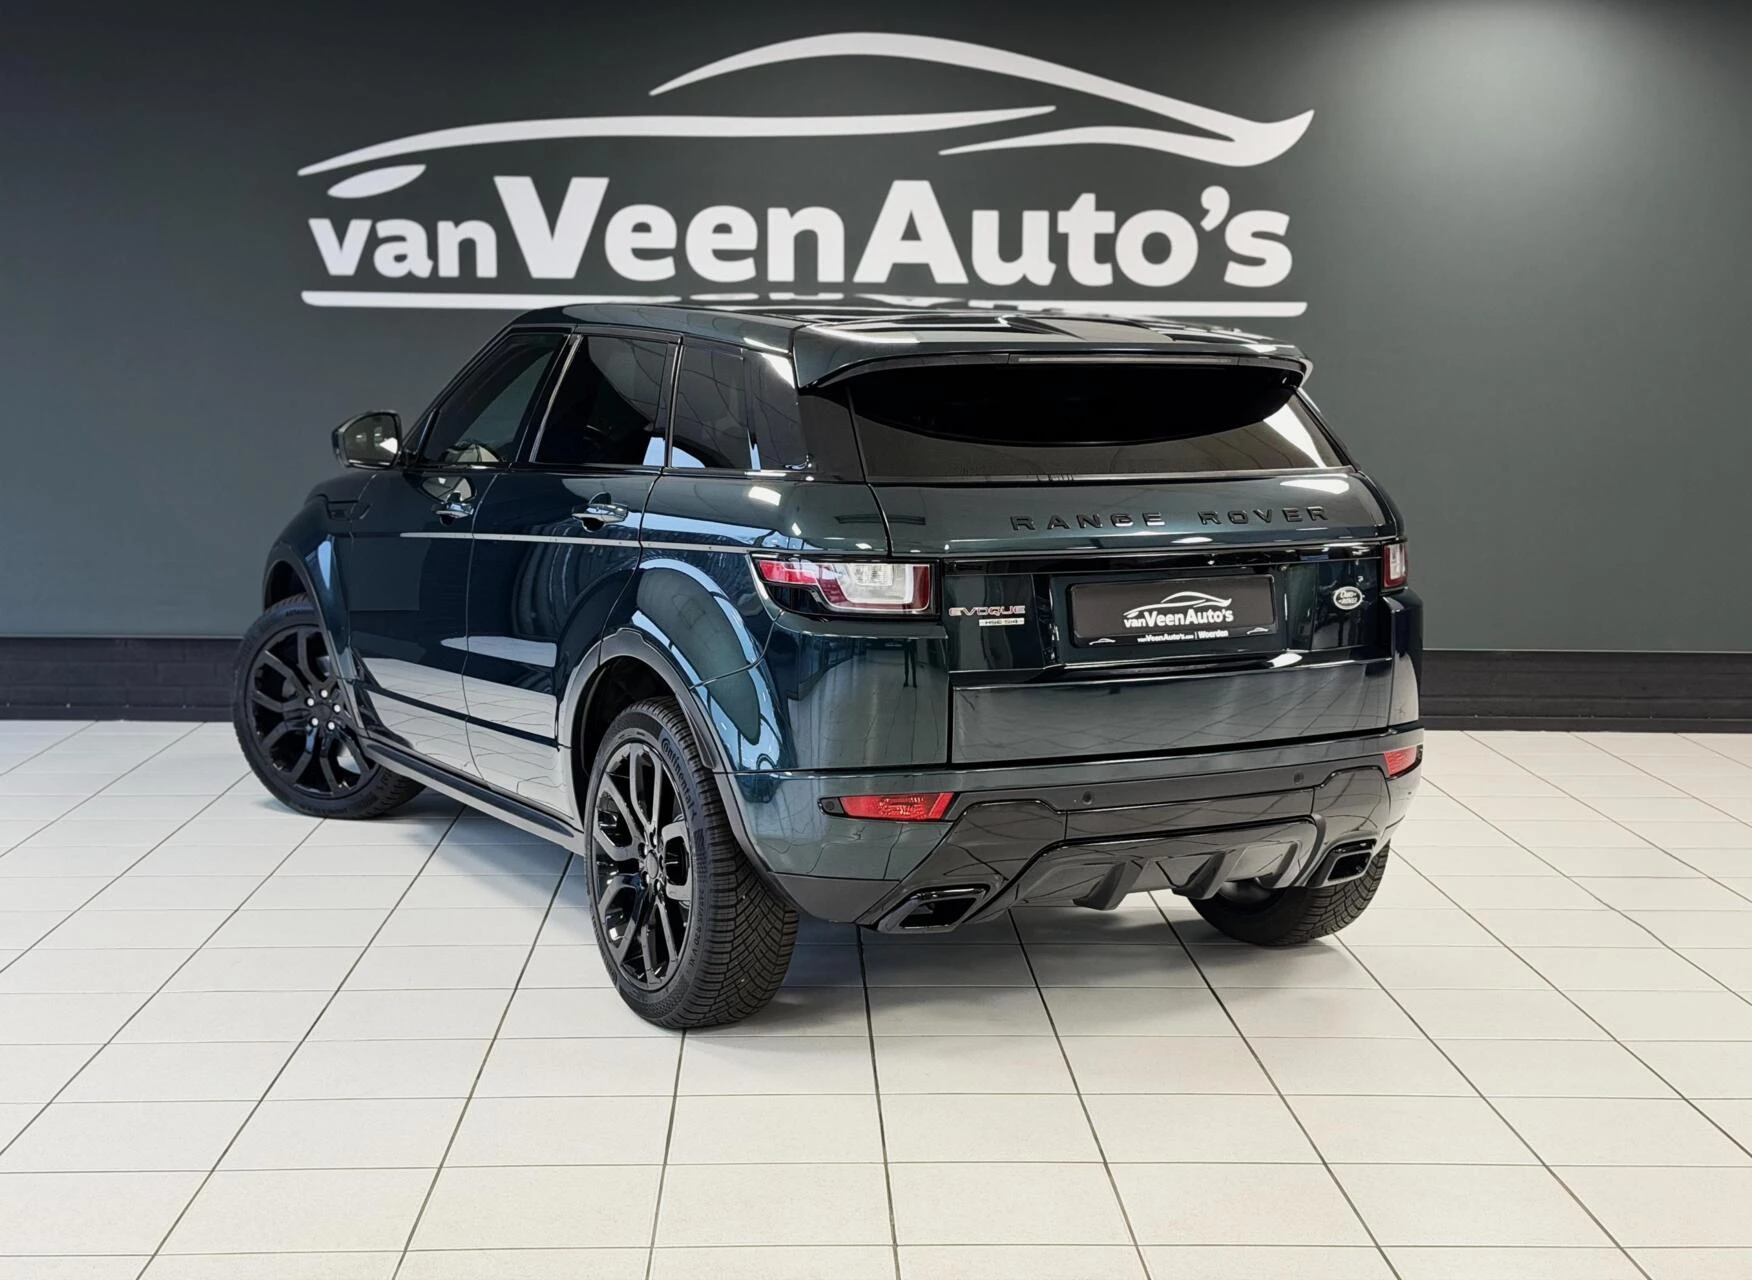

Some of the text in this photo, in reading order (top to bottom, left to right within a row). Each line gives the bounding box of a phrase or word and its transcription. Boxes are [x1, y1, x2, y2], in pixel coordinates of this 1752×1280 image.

[308, 176, 1293, 287] vanVeenAuto's
[1010, 506, 1329, 531] RANGE ROVER
[949, 605, 1026, 617] EVOQUE
[1123, 609, 1234, 628] vanVeenAuto's
[1198, 630, 1229, 639] Woerden
